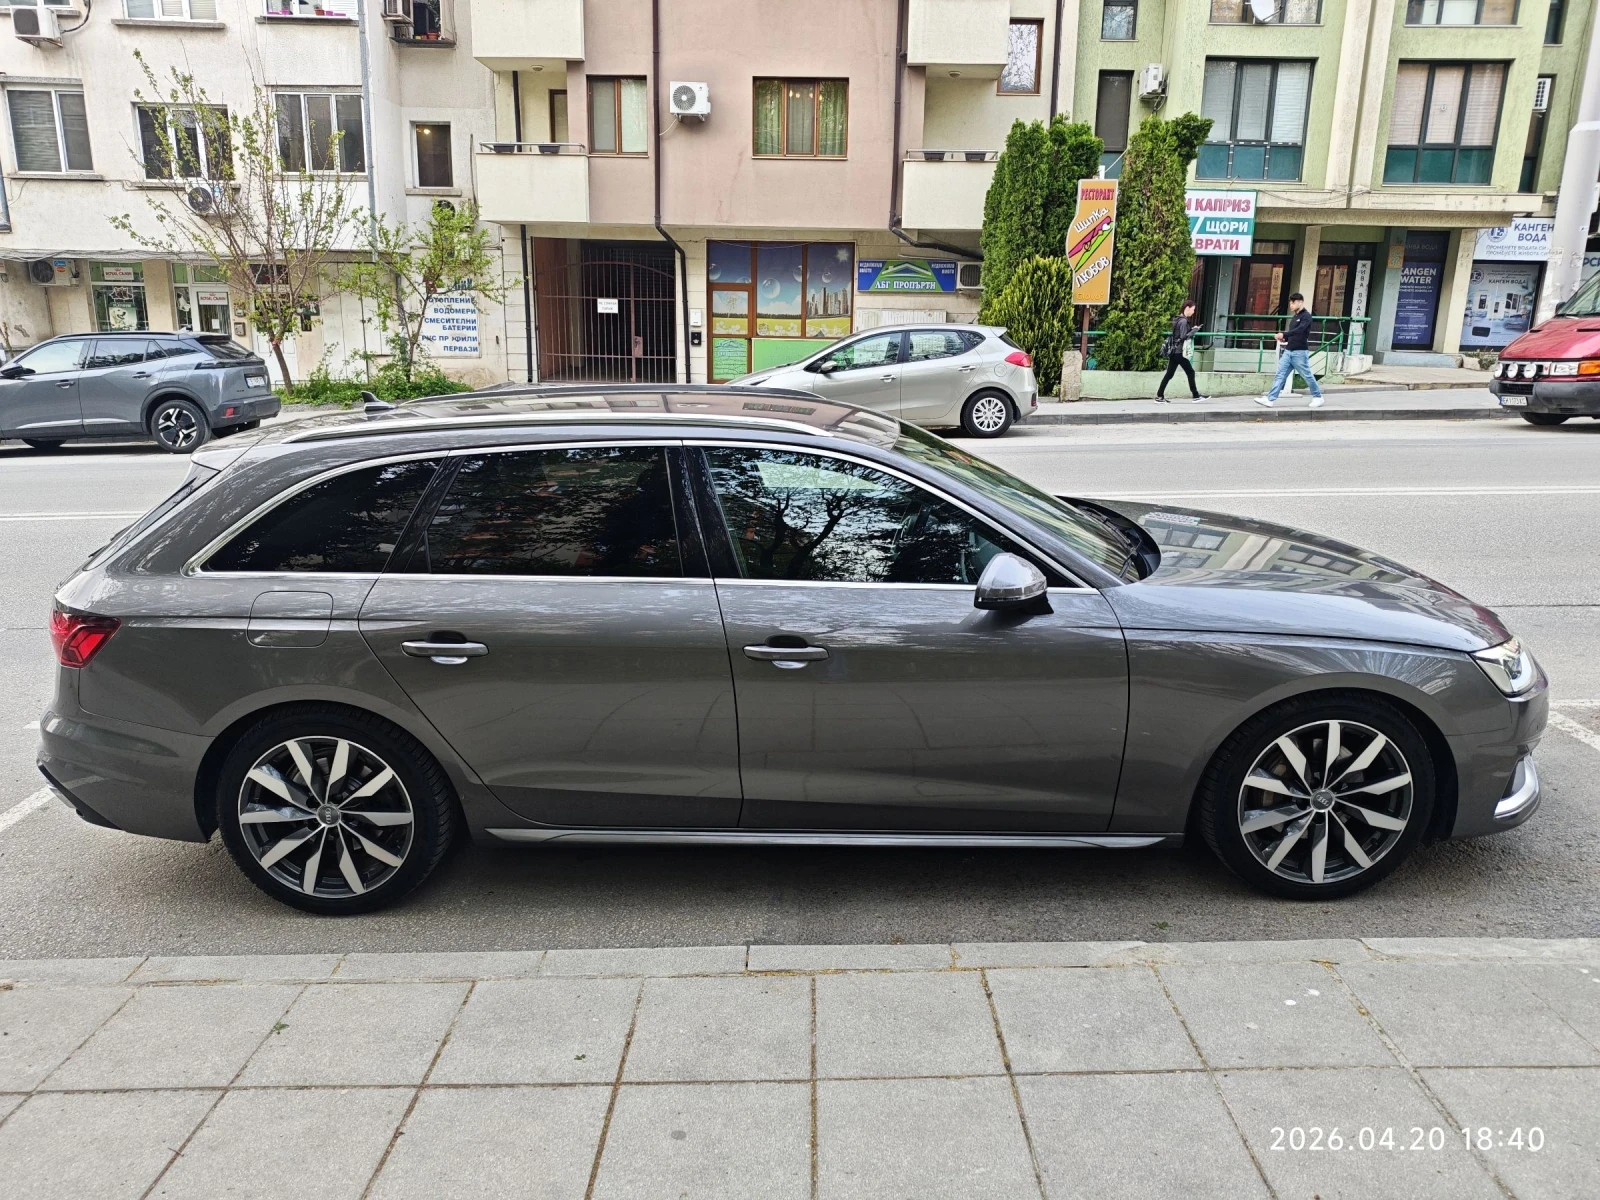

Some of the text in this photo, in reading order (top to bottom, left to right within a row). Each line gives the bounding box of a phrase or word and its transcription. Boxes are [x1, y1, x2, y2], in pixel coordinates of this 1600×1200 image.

[1081, 188, 1114, 200] РЕСТОРАНТ
[1194, 198, 1251, 212] КАПРИЗ
[1205, 221, 1249, 233] ЩОРИ
[1514, 223, 1554, 232] КАНГЕН
[1517, 233, 1547, 242] ВОДА
[1194, 239, 1240, 250] ВРАТИ
[1075, 256, 1110, 288] ЛЮБОВ
[893, 281, 936, 289] ПРОПЪРТИ
